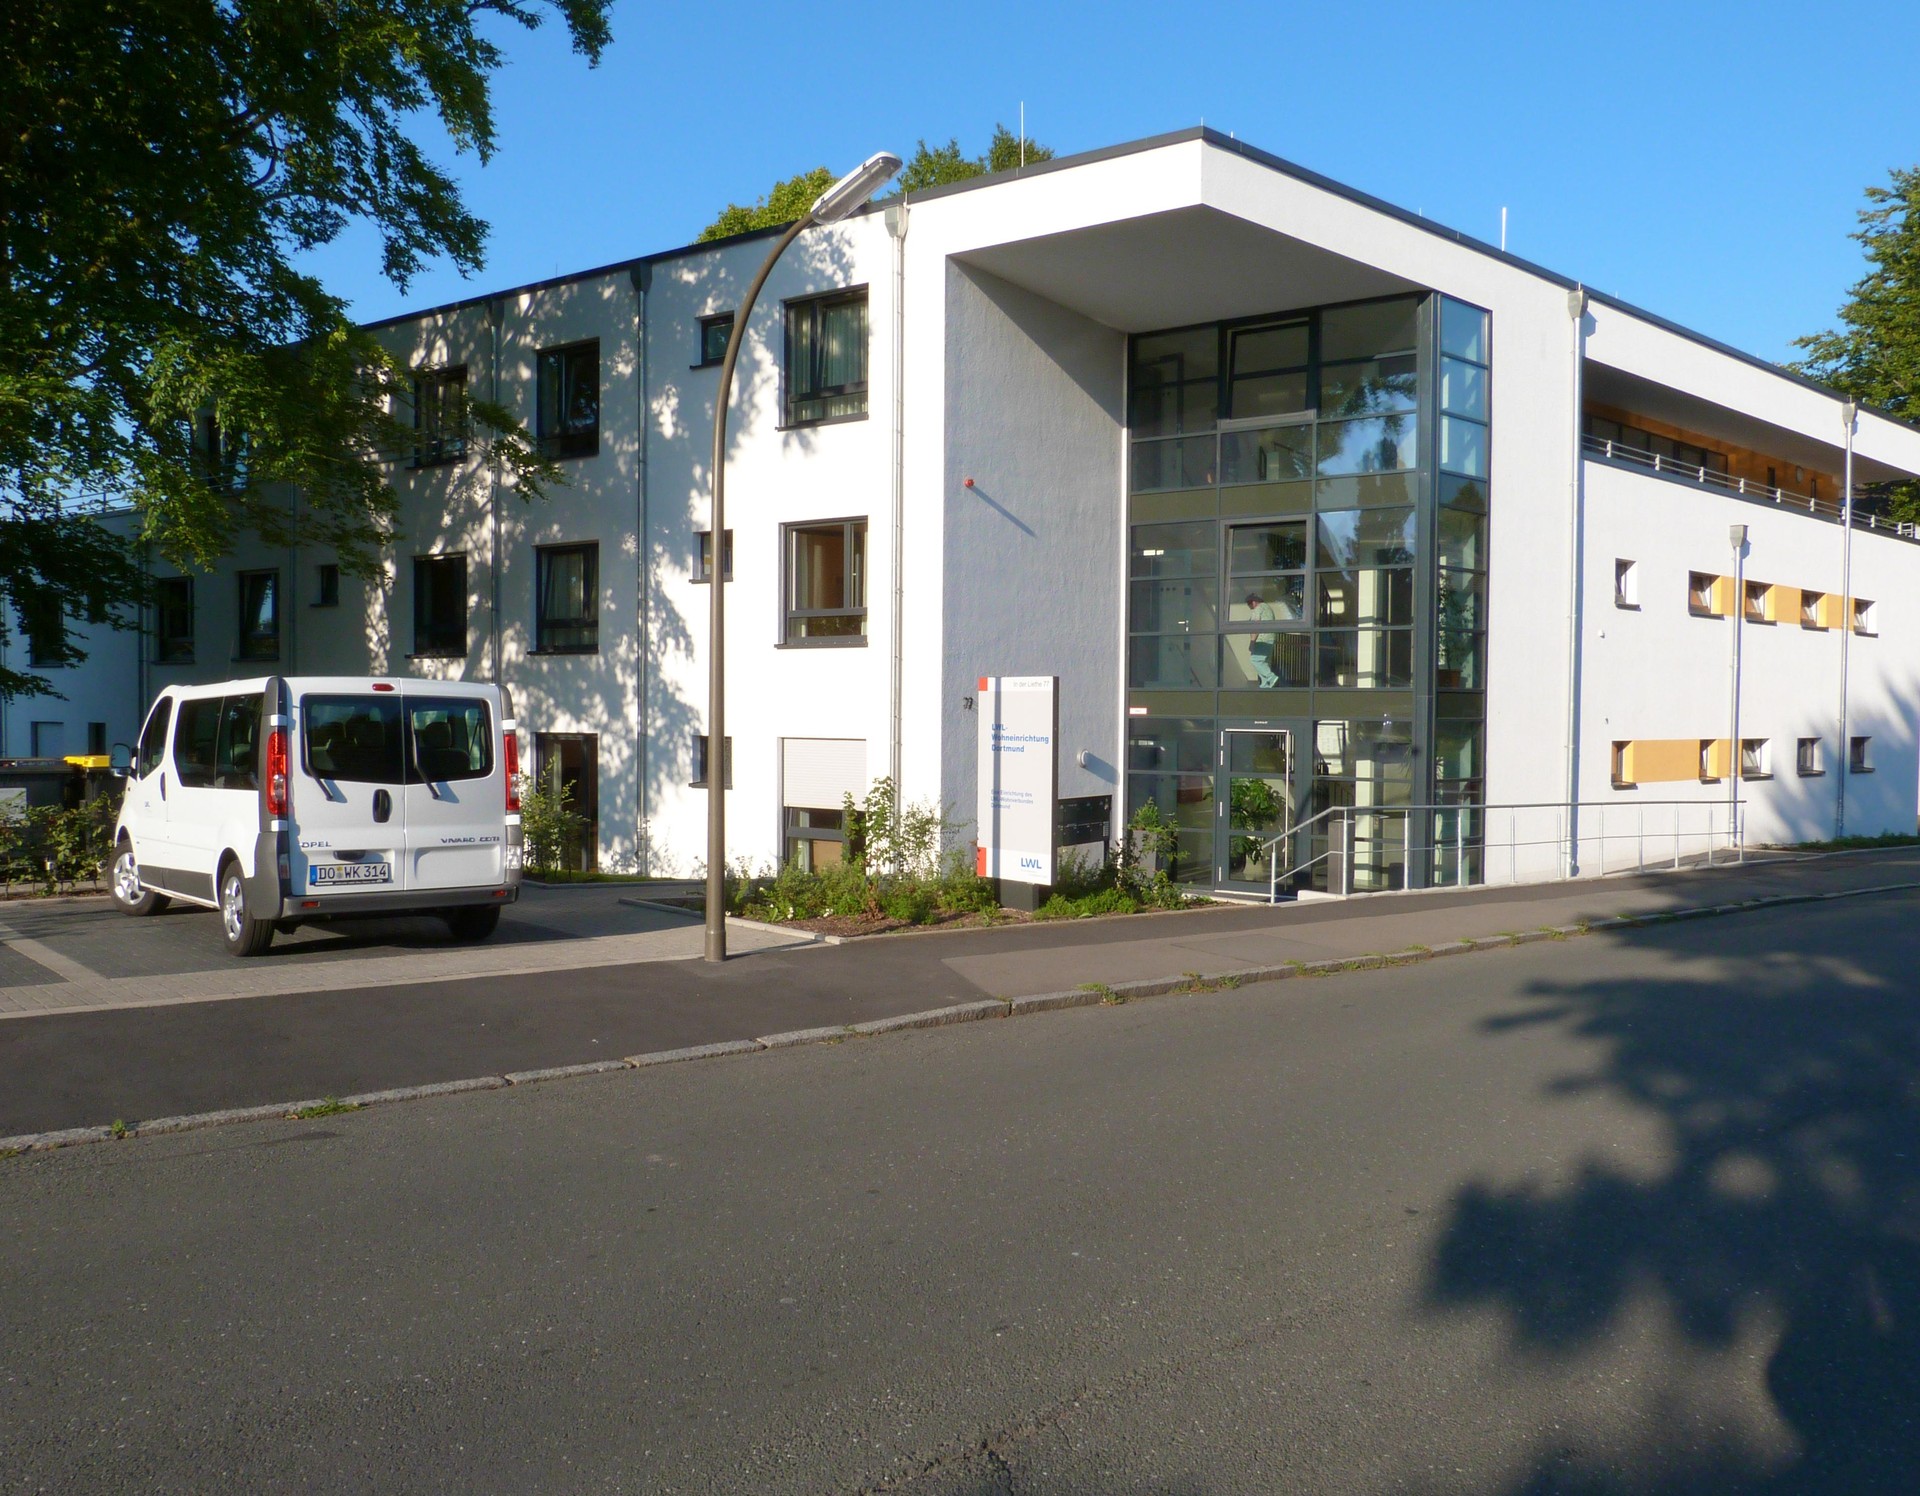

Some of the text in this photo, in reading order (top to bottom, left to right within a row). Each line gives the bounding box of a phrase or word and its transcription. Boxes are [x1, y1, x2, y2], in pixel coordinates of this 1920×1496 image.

[992, 734, 1049, 744] Wohneinrichtung
[992, 744, 1025, 753] Dortmund
[1021, 857, 1042, 870] LWL
[318, 864, 387, 881] DO WK 314
